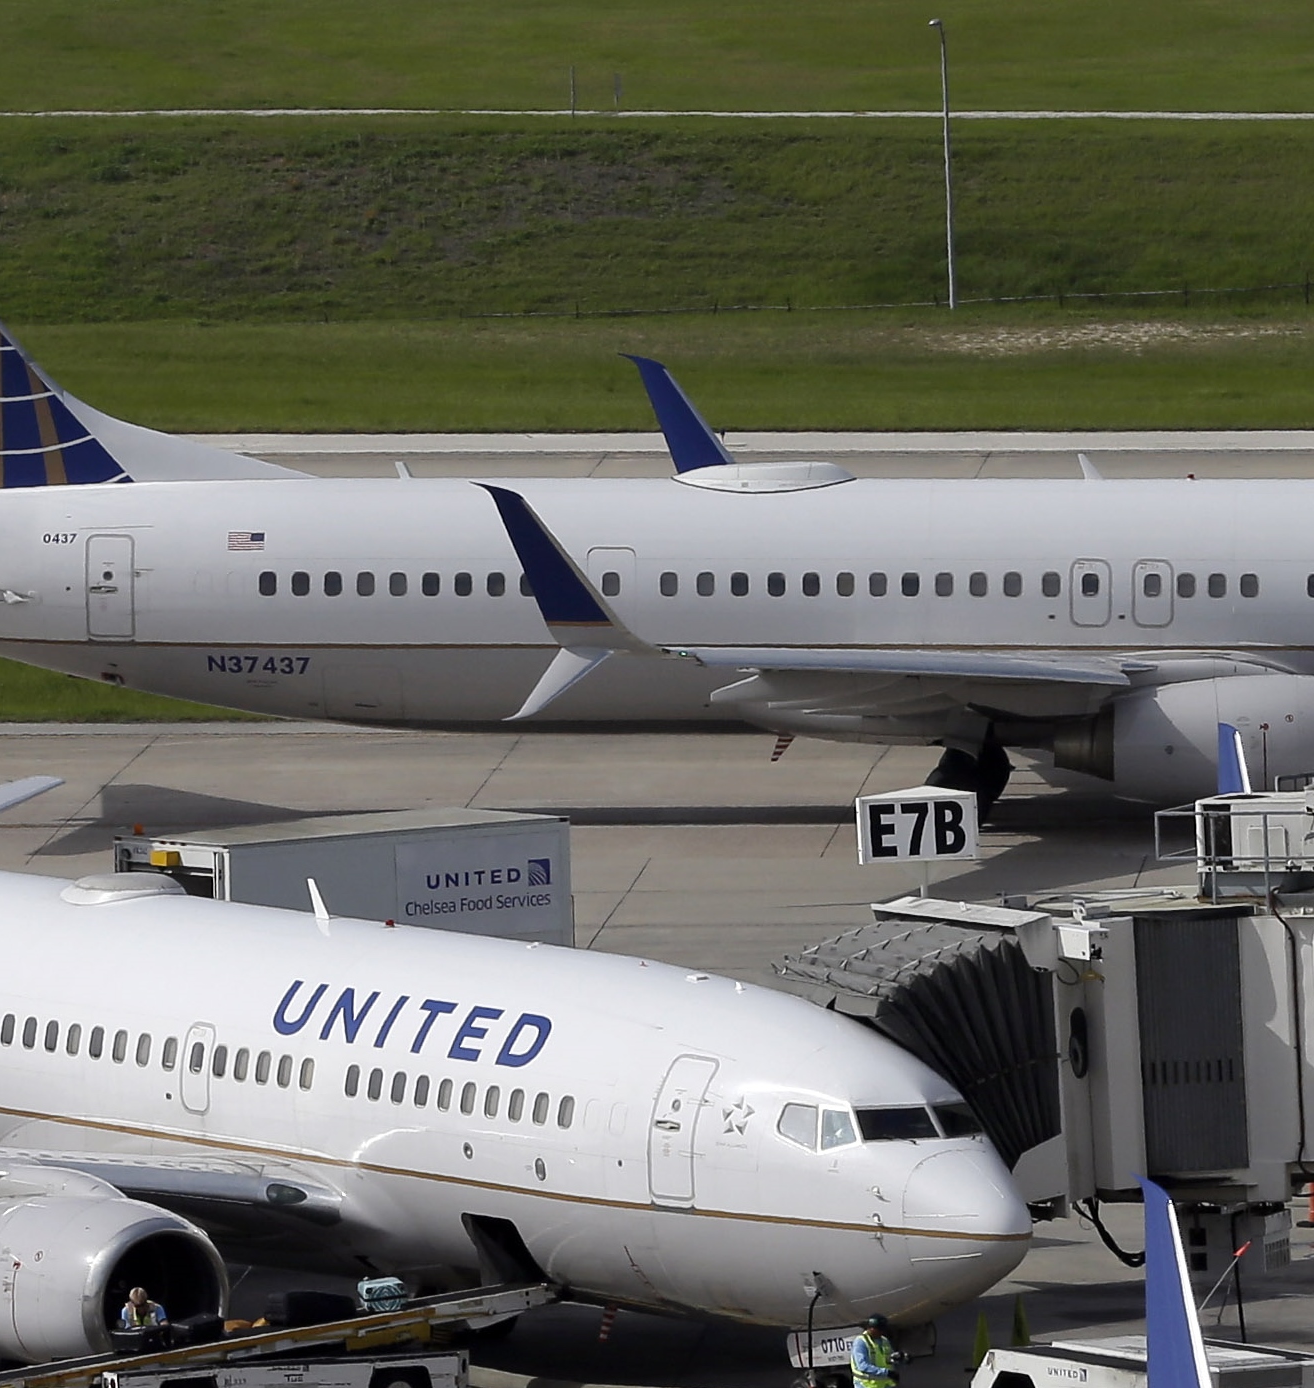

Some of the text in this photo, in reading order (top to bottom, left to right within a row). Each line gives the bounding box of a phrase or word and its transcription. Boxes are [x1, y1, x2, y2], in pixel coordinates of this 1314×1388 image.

[42, 533, 77, 544] 0437
[207, 655, 311, 675] N37437
[869, 800, 966, 858] E7B
[426, 867, 522, 890] UNITED
[405, 892, 552, 917] Chelsea Food Services
[272, 979, 553, 1069] UNITED
[820, 1338, 846, 1354] 0710
